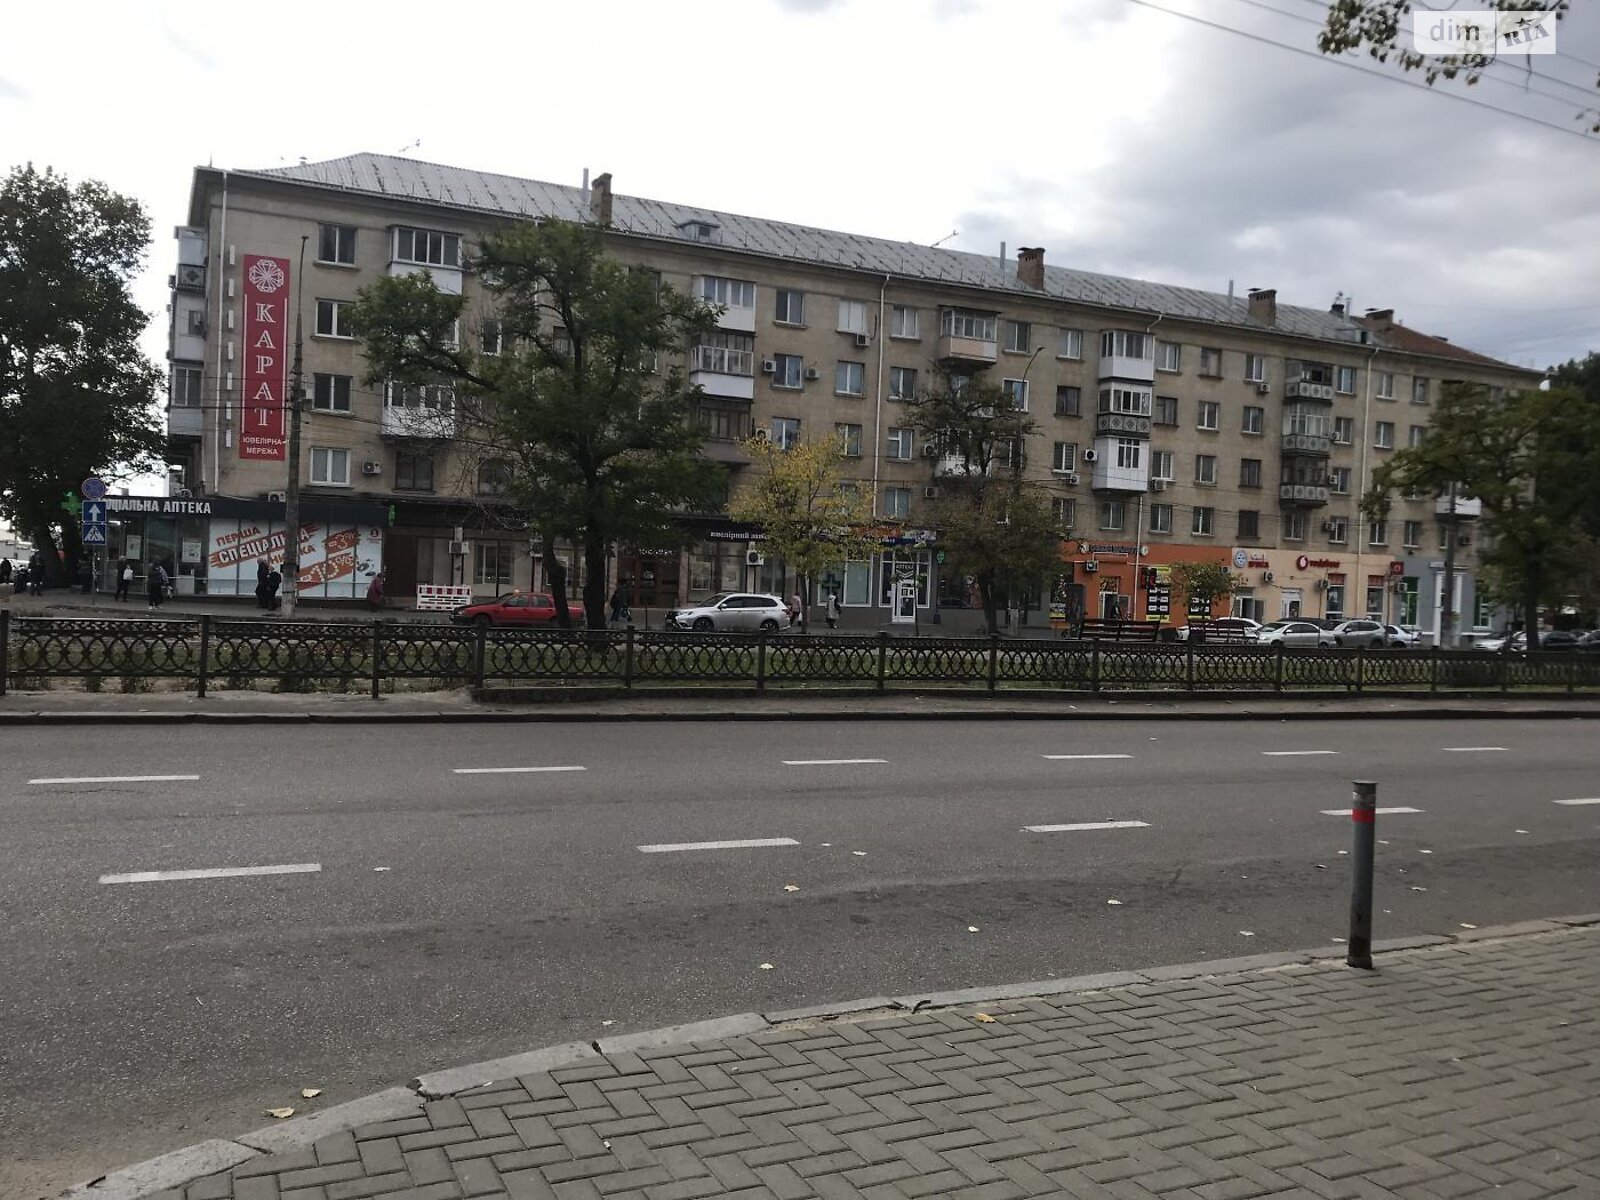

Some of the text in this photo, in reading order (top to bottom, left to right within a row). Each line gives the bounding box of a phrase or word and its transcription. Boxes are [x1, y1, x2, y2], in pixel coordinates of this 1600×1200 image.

[253, 302, 276, 427] КАРАТ
[242, 436, 282, 446] ЮВЕЛІРНА
[246, 447, 279, 456] МЕРЕЖА
[104, 498, 212, 514] ОЦІАЛЬНА АПТЕКА
[216, 526, 261, 547] ПЕРША
[219, 527, 310, 564] СПЕЦІАЛА
